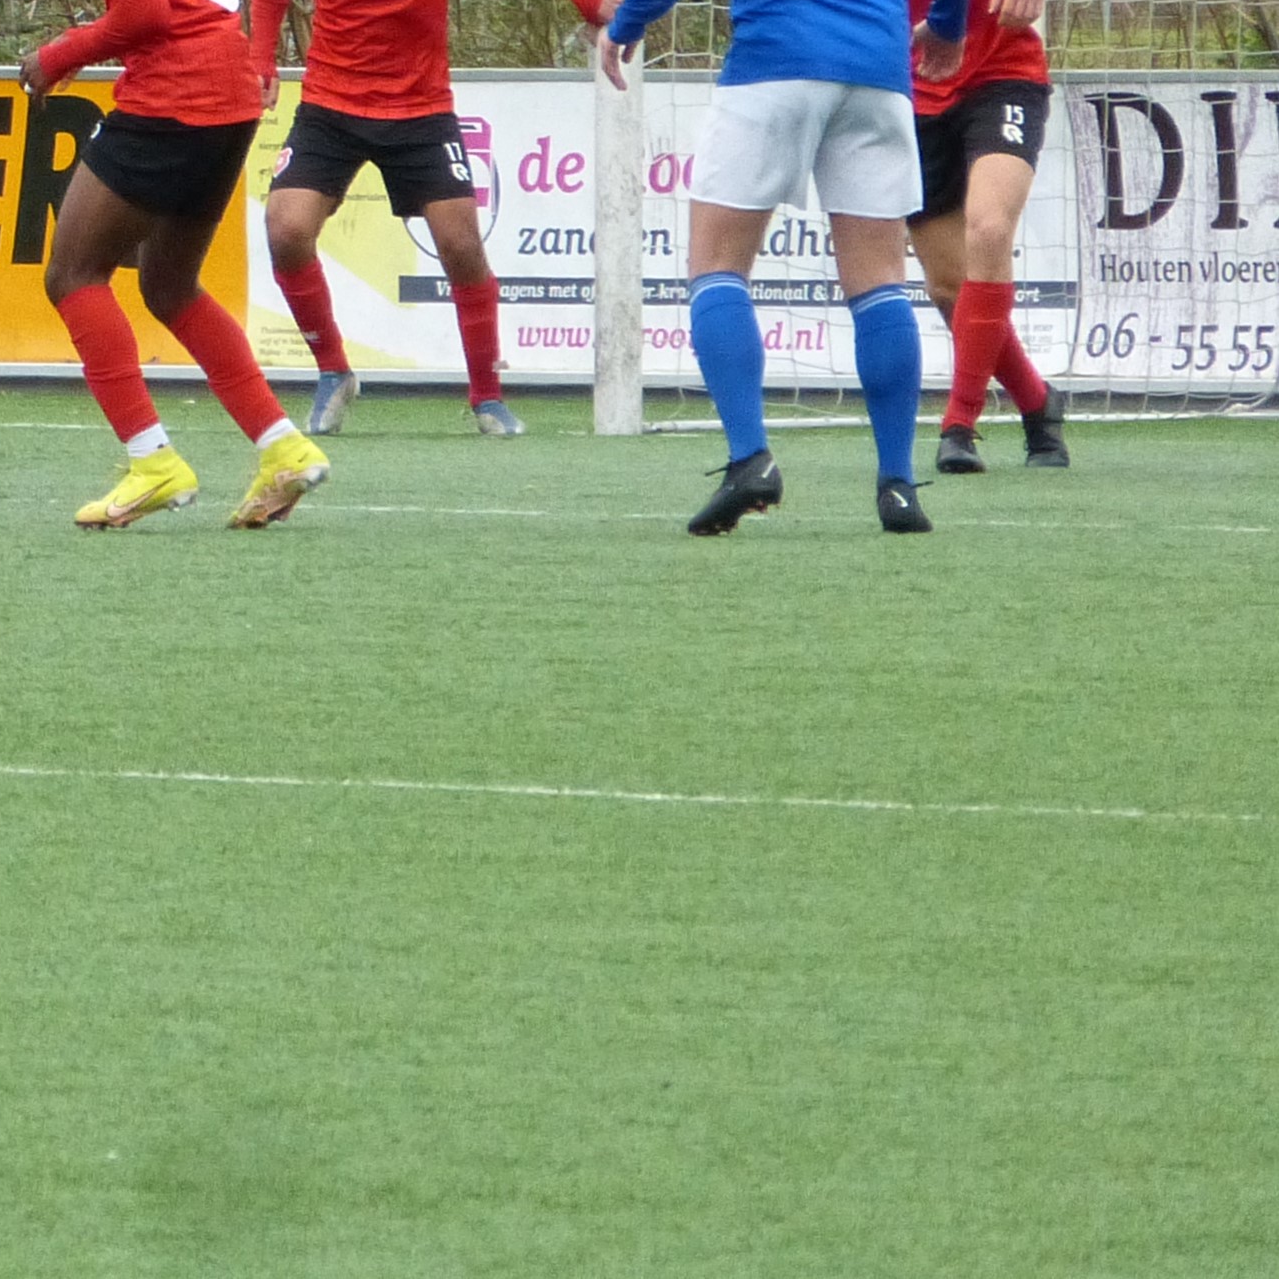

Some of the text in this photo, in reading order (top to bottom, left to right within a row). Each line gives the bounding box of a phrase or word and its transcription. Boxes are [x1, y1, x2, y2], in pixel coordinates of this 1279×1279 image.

[1004, 104, 1024, 125] 15
[518, 135, 585, 194] de
[1084, 91, 1279, 230] DI
[548, 283, 577, 298] met
[1100, 251, 1279, 284] Houten vloere
[1087, 312, 1139, 359] 06
[1172, 324, 1219, 371] 55
[1228, 324, 1275, 371] 55
